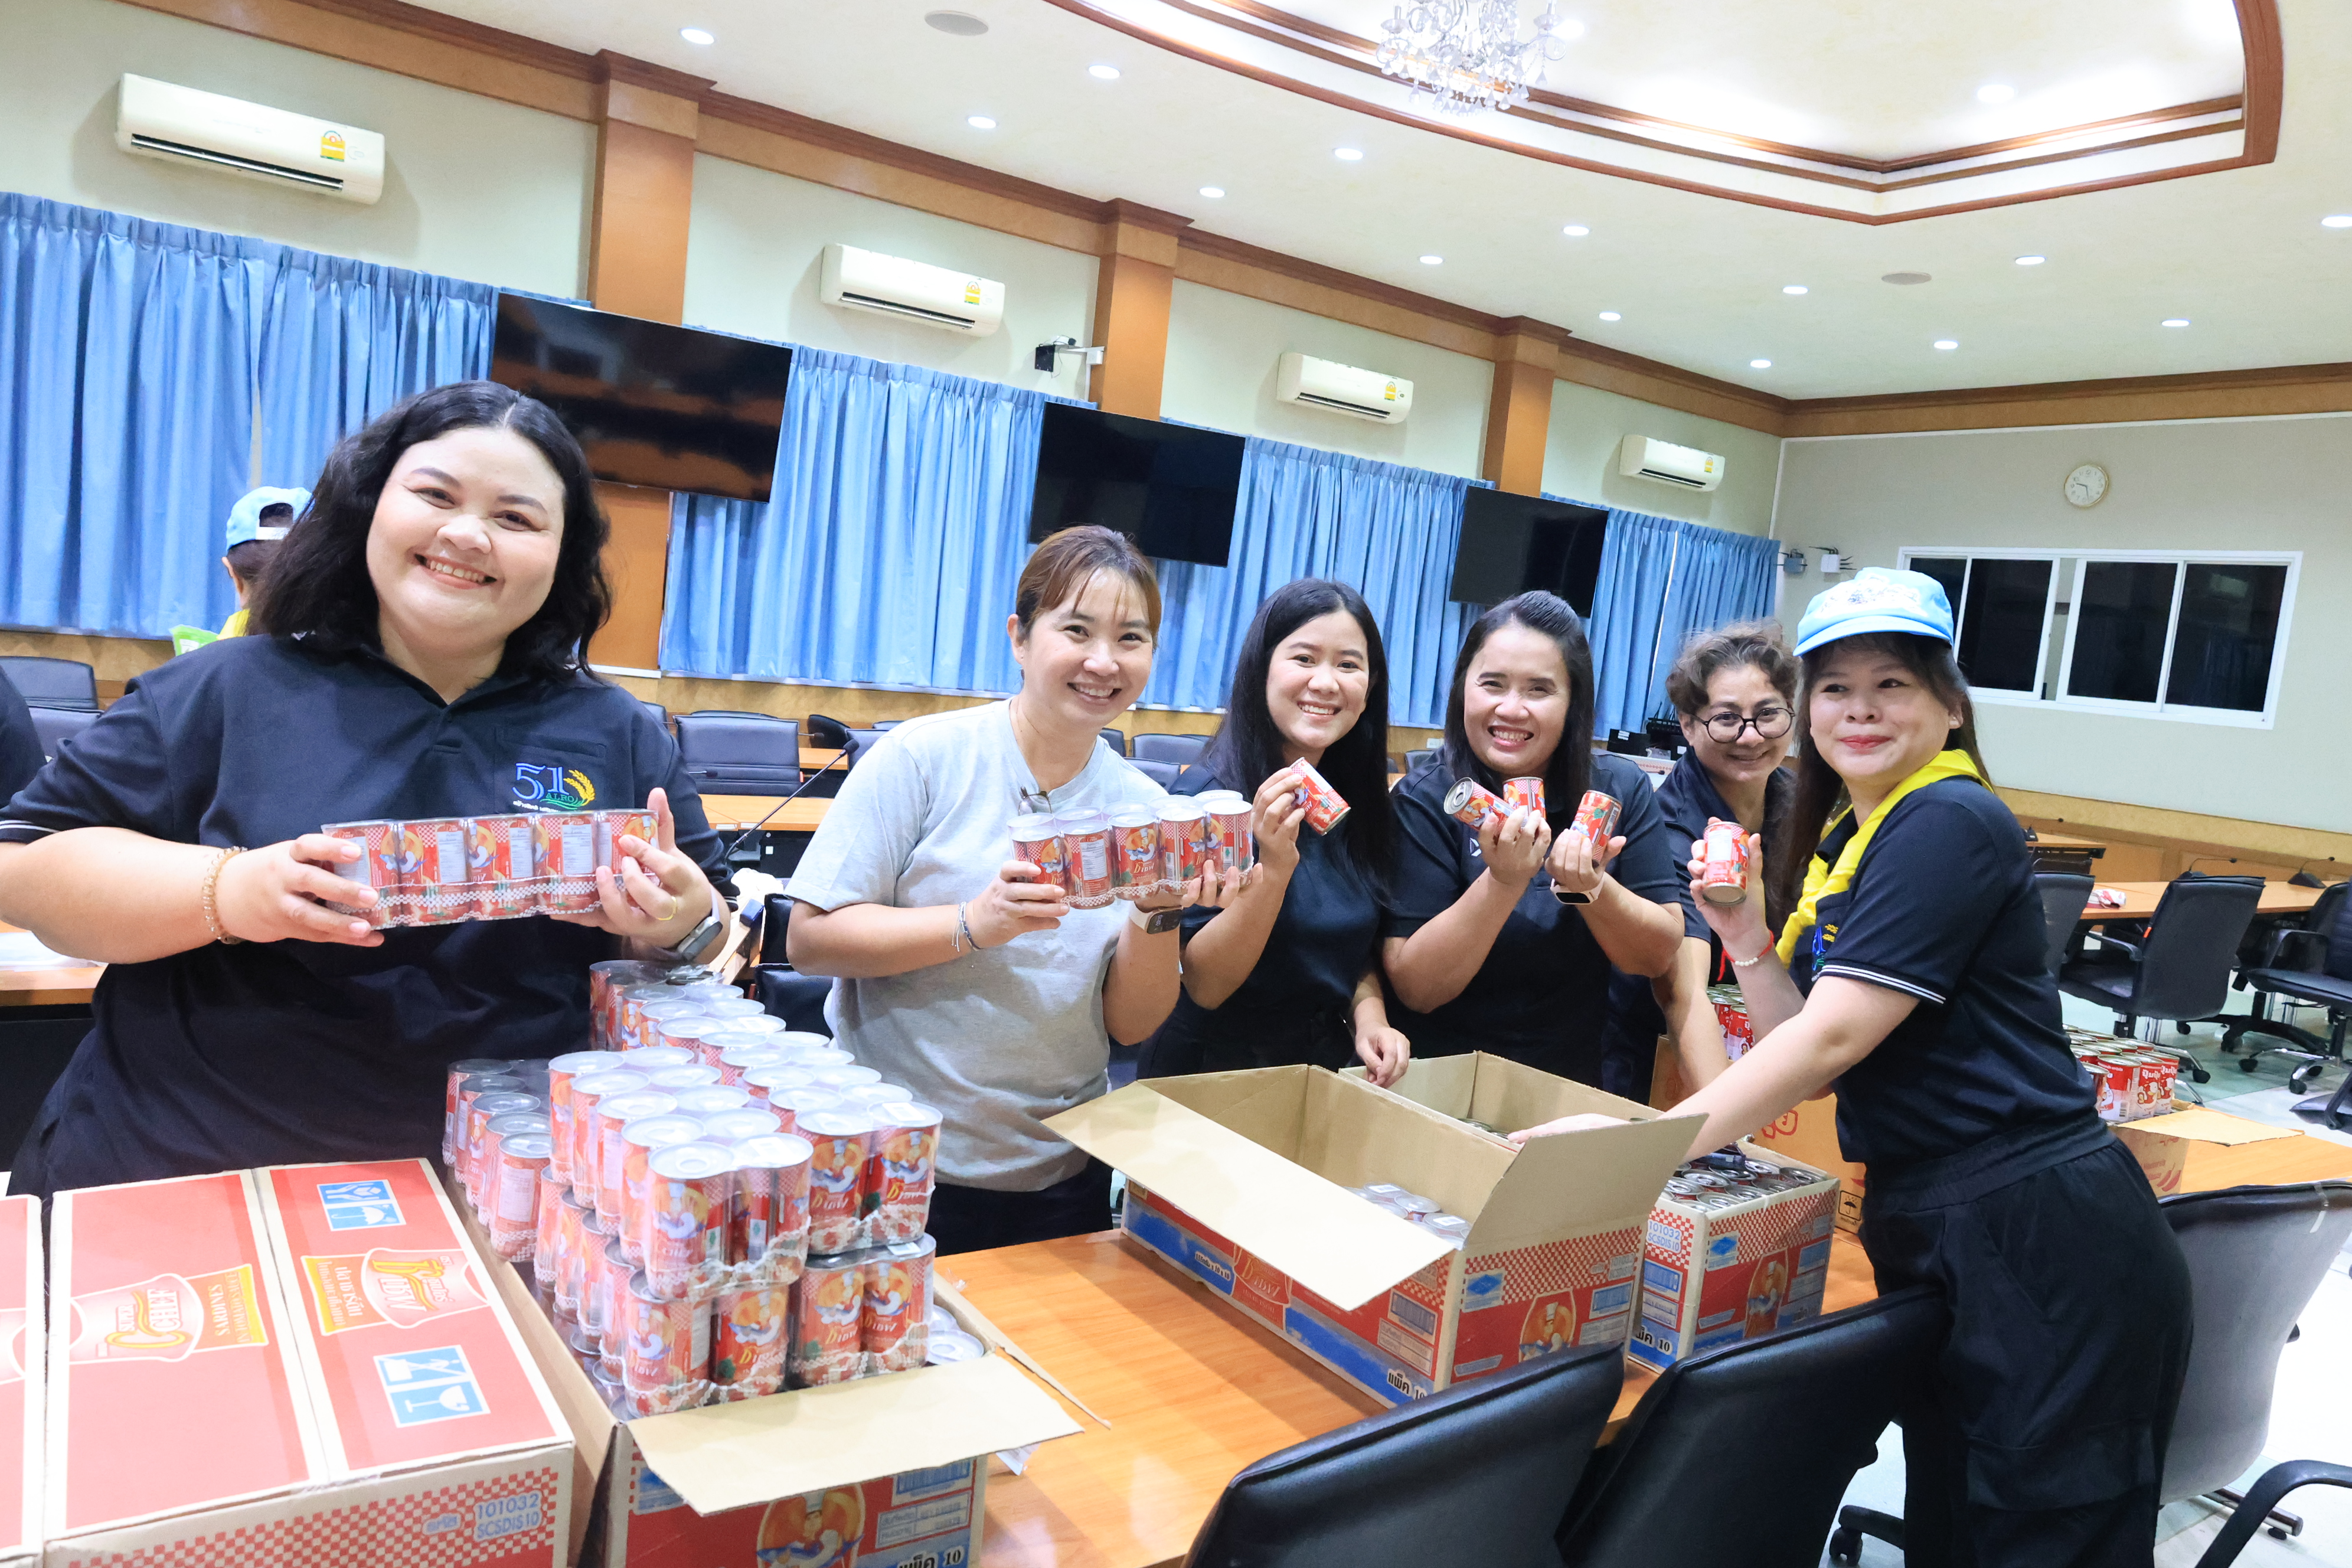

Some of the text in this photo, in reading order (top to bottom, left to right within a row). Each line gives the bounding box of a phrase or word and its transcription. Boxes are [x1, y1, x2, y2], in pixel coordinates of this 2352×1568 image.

[512, 762, 570, 800] 51
[545, 792, 574, 802] ALRO
[1648, 1233, 1680, 1252] SCSDIS10
[1649, 1221, 1680, 1240] 101032
[119, 1304, 136, 1332] SUPER
[147, 1288, 181, 1332] CHEF
[208, 1283, 231, 1337] SARDINES
[230, 1298, 250, 1331] TOMATO
[237, 1331, 252, 1343] IN
[1659, 1339, 1670, 1353] 10
[479, 1493, 540, 1519] 101032
[478, 1511, 540, 1539] SCSDIS10
[945, 1549, 962, 1566] 10
